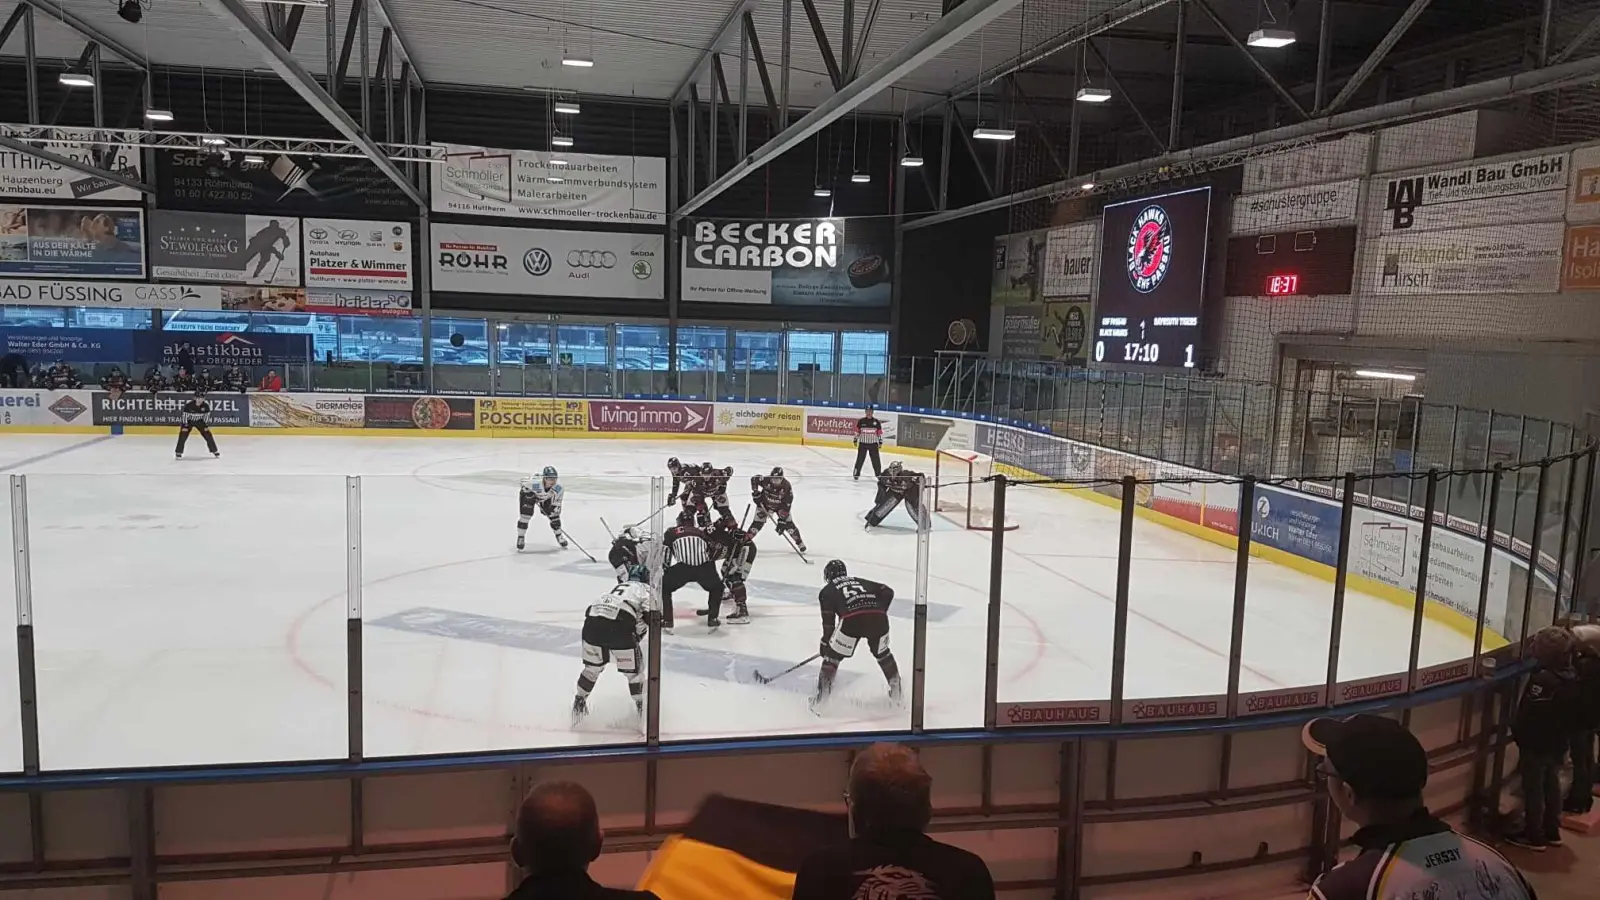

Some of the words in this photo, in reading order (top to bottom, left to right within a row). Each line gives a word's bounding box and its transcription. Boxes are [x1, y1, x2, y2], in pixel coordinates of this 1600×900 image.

[516, 159, 618, 173] Trockenbauarbeiten
[1428, 170, 1471, 189] Wandl
[1476, 167, 1506, 183] Bau
[1511, 157, 1563, 178] GmbH
[2, 175, 63, 187] Hauzenberg
[517, 189, 588, 201] Malerarbeiten
[1251, 189, 1337, 213] #schustergruppe
[518, 205, 658, 220] www.schmoeller-trockenbau.de
[1138, 208, 1165, 228] HAWKS
[695, 220, 836, 245] BECKER
[33, 241, 50, 249] AUS
[51, 242, 69, 250] DER
[60, 249, 93, 258] WÄRME
[1128, 227, 1140, 273] BLACK
[694, 244, 837, 268] CARBON
[1136, 275, 1151, 290] EHF
[1151, 235, 1172, 286] PASSAU
[310, 258, 348, 268] Platzer
[351, 259, 359, 269] &
[361, 259, 407, 271] Wimmer
[1063, 253, 1091, 276] bauer
[568, 271, 590, 280] Audi
[0, 284, 32, 300] AD
[38, 282, 123, 302] FÜSSING
[135, 286, 177, 301] GASS
[1270, 276, 1298, 293] 18:37
[8, 340, 31, 348] Walter
[49, 341, 70, 349] GmbH
[206, 357, 263, 365] OBERNEDER
[1095, 340, 1105, 362] 0
[1123, 342, 1159, 363] 17:10
[1184, 343, 1195, 368] 1
[101, 398, 163, 411] RICHTER
[178, 399, 240, 412] FNZEL
[601, 405, 638, 428] living
[640, 405, 682, 424] immo
[735, 409, 775, 420] eichberger
[778, 413, 801, 421] reisen
[811, 417, 853, 430] Apotheke
[987, 428, 1025, 452] HESKO
[1379, 499, 1405, 513] BAUHAUS
[1250, 520, 1280, 541] URICH
[1452, 519, 1478, 535] BAUHAUS
[1428, 664, 1469, 682] BAUHAUS
[1352, 680, 1401, 698] BAUHAUS
[1258, 692, 1318, 708] BAUHAUS
[1022, 707, 1099, 721] BAUHAUS
[1145, 702, 1217, 717] BAUHAUS
